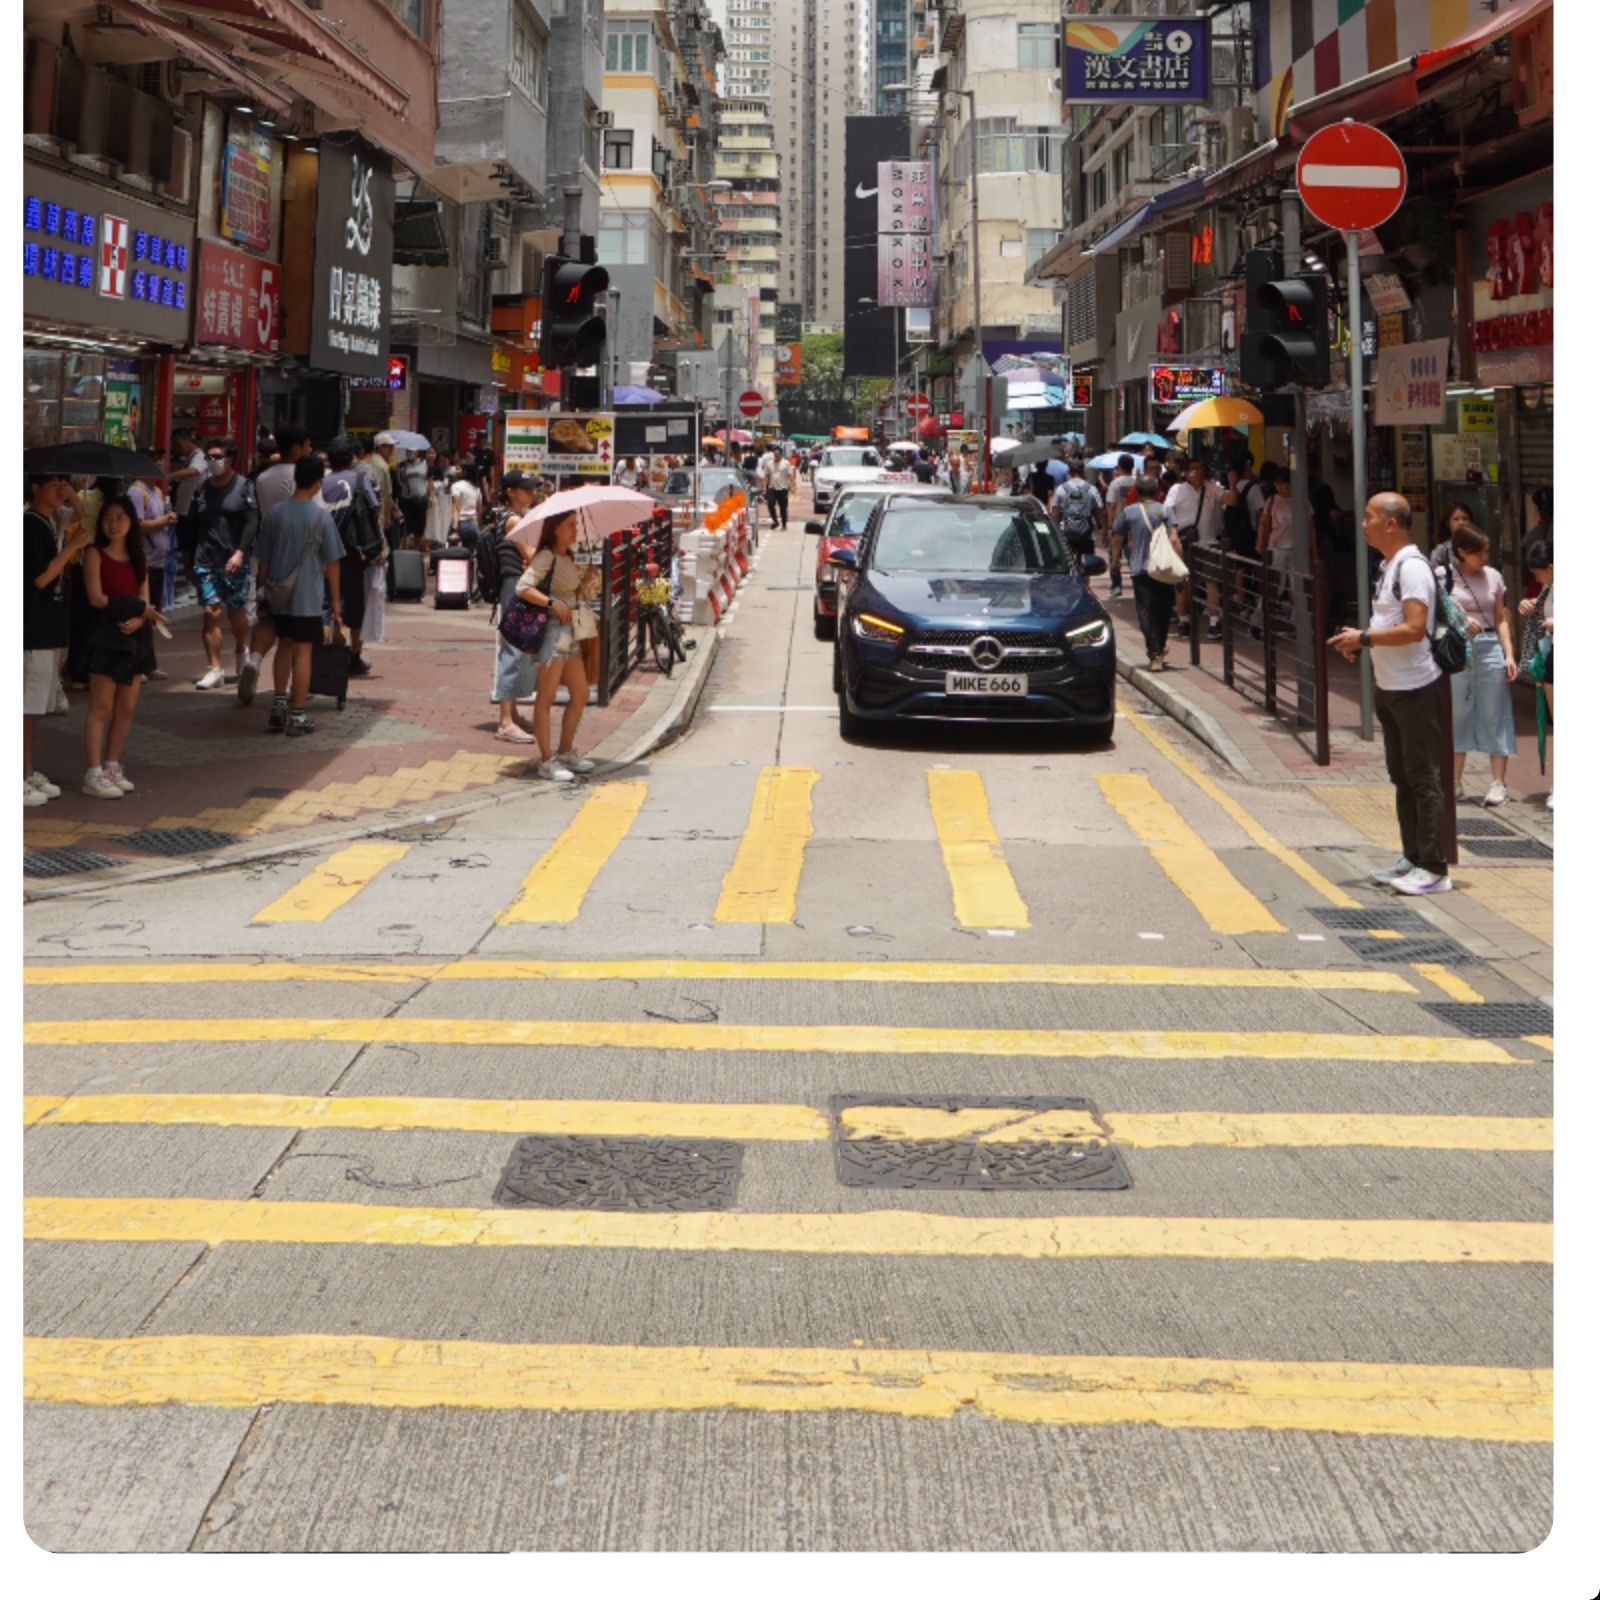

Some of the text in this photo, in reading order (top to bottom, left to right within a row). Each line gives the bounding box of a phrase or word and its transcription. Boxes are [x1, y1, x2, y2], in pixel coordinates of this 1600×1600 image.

[1084, 53, 1190, 79] 漢文書店
[257, 269, 273, 345] 5
